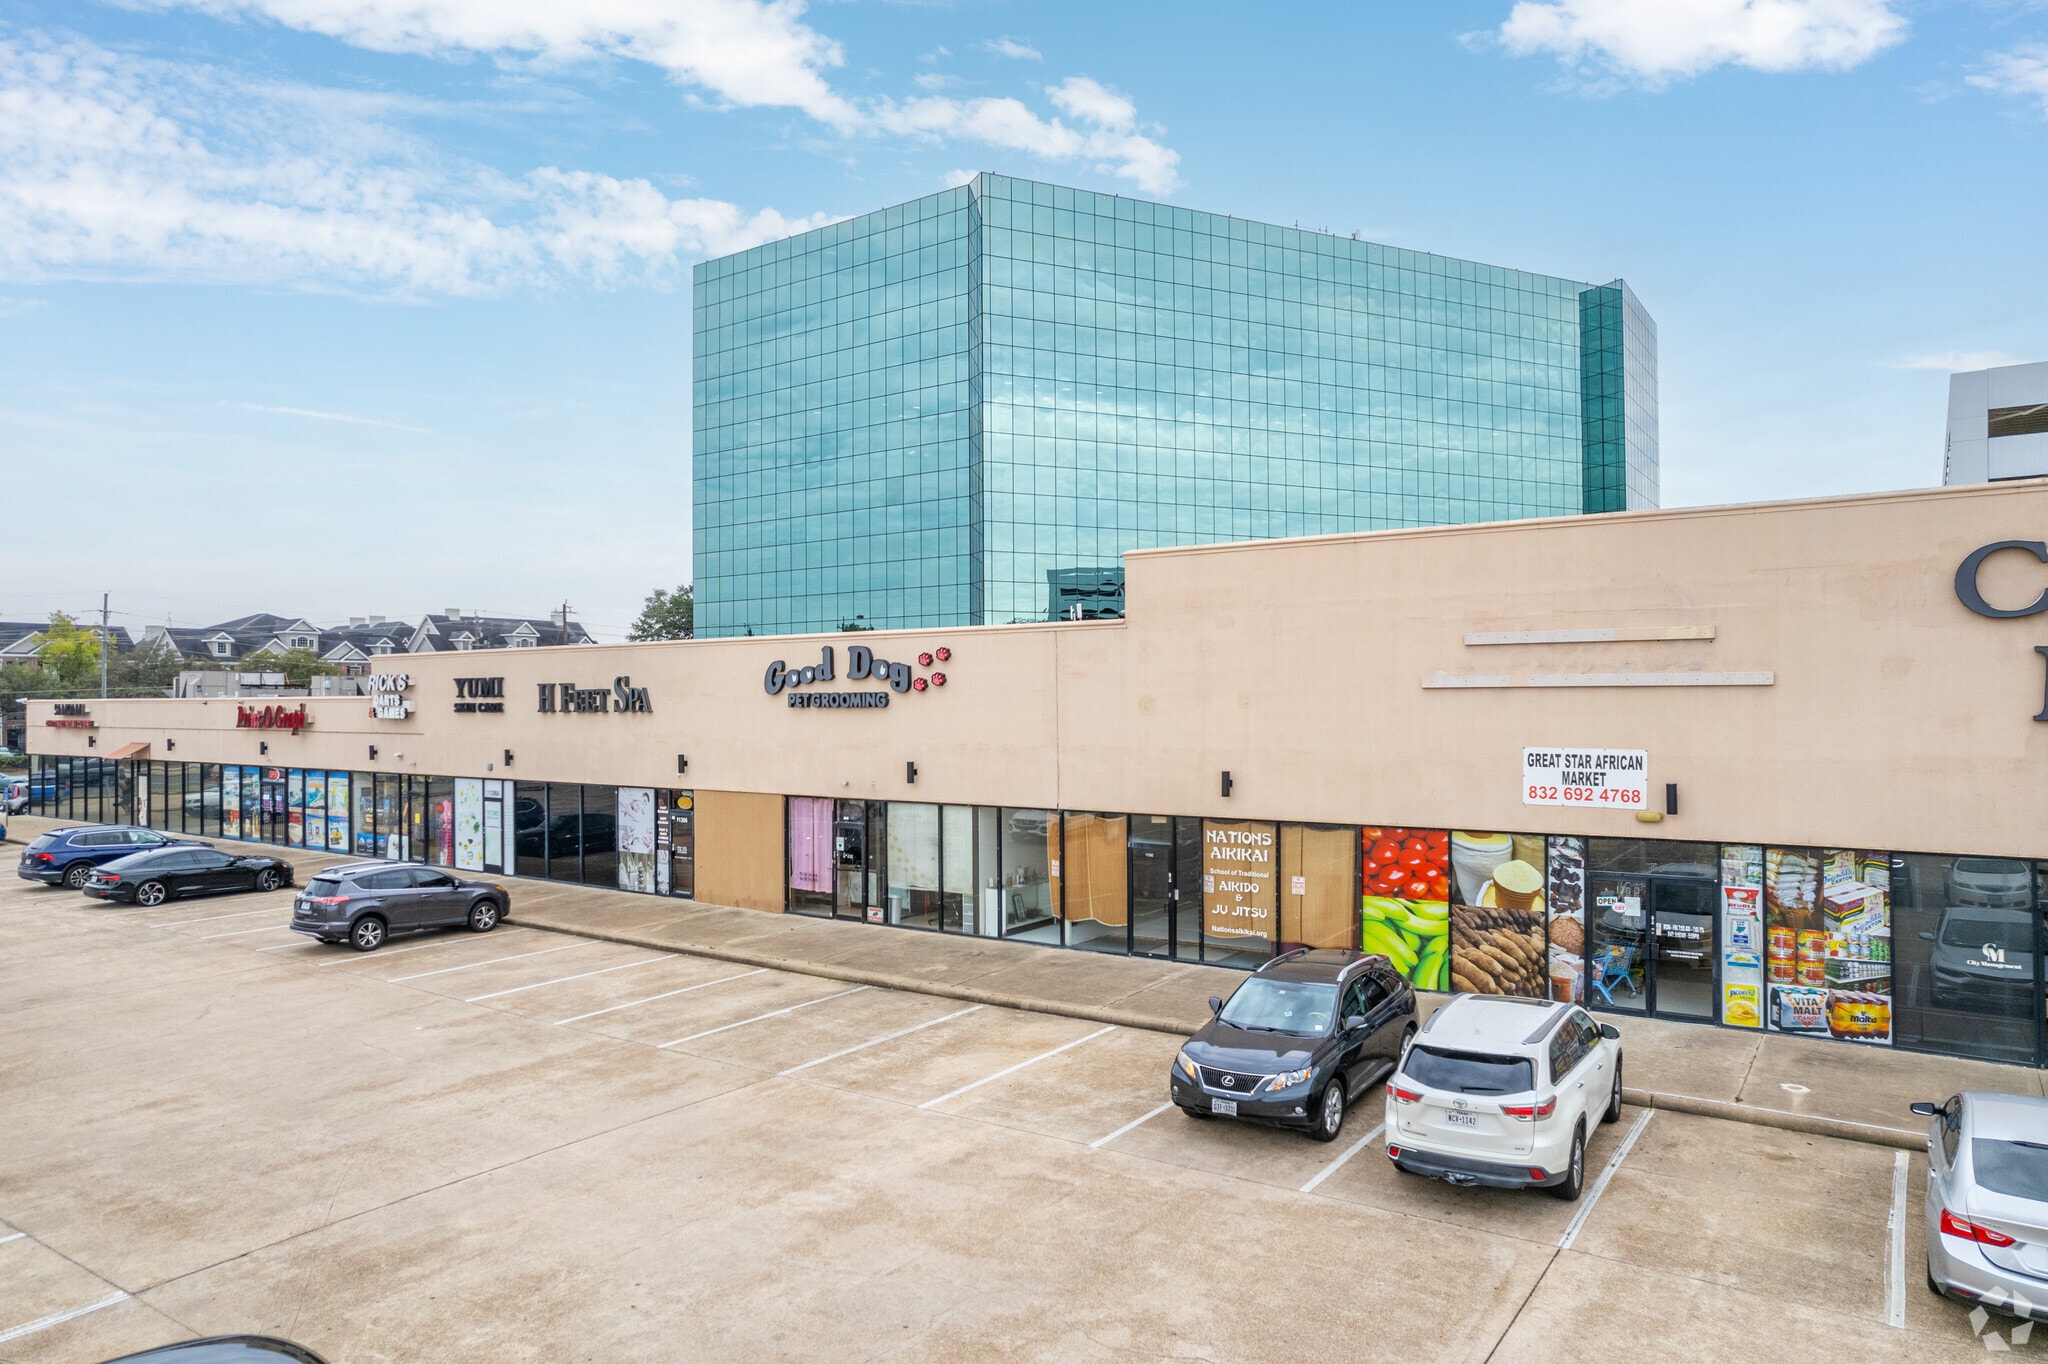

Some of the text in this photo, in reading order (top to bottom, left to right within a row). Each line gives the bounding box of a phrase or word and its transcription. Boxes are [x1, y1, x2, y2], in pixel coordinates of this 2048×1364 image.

[764, 645, 912, 695] Good Dog
[453, 677, 505, 698] YUMI
[537, 675, 653, 713] H FEET SPA
[373, 694, 402, 707] DARTS
[788, 692, 889, 708] PET GROOMING
[378, 707, 408, 719] GAMES
[454, 703, 477, 713] SKIN
[1527, 753, 1643, 770] GREAT STAR AFRICAN
[1562, 771, 1606, 786] MARKET
[1529, 786, 1641, 803] 832 692 4768
[1206, 830, 1272, 846] NATIONS
[1211, 847, 1268, 862] AIKIKAI
[1210, 868, 1230, 876] School
[1239, 870, 1270, 878] Traditional
[1219, 881, 1259, 893] AIKIDO
[1235, 894, 1243, 902] &
[1212, 904, 1267, 918] JU JITSU
[1212, 925, 1268, 938] Nationsaikikai.org
[1980, 961, 2022, 970] Management
[1793, 997, 1819, 1006] VITA
[1792, 1006, 1822, 1015] MALT
